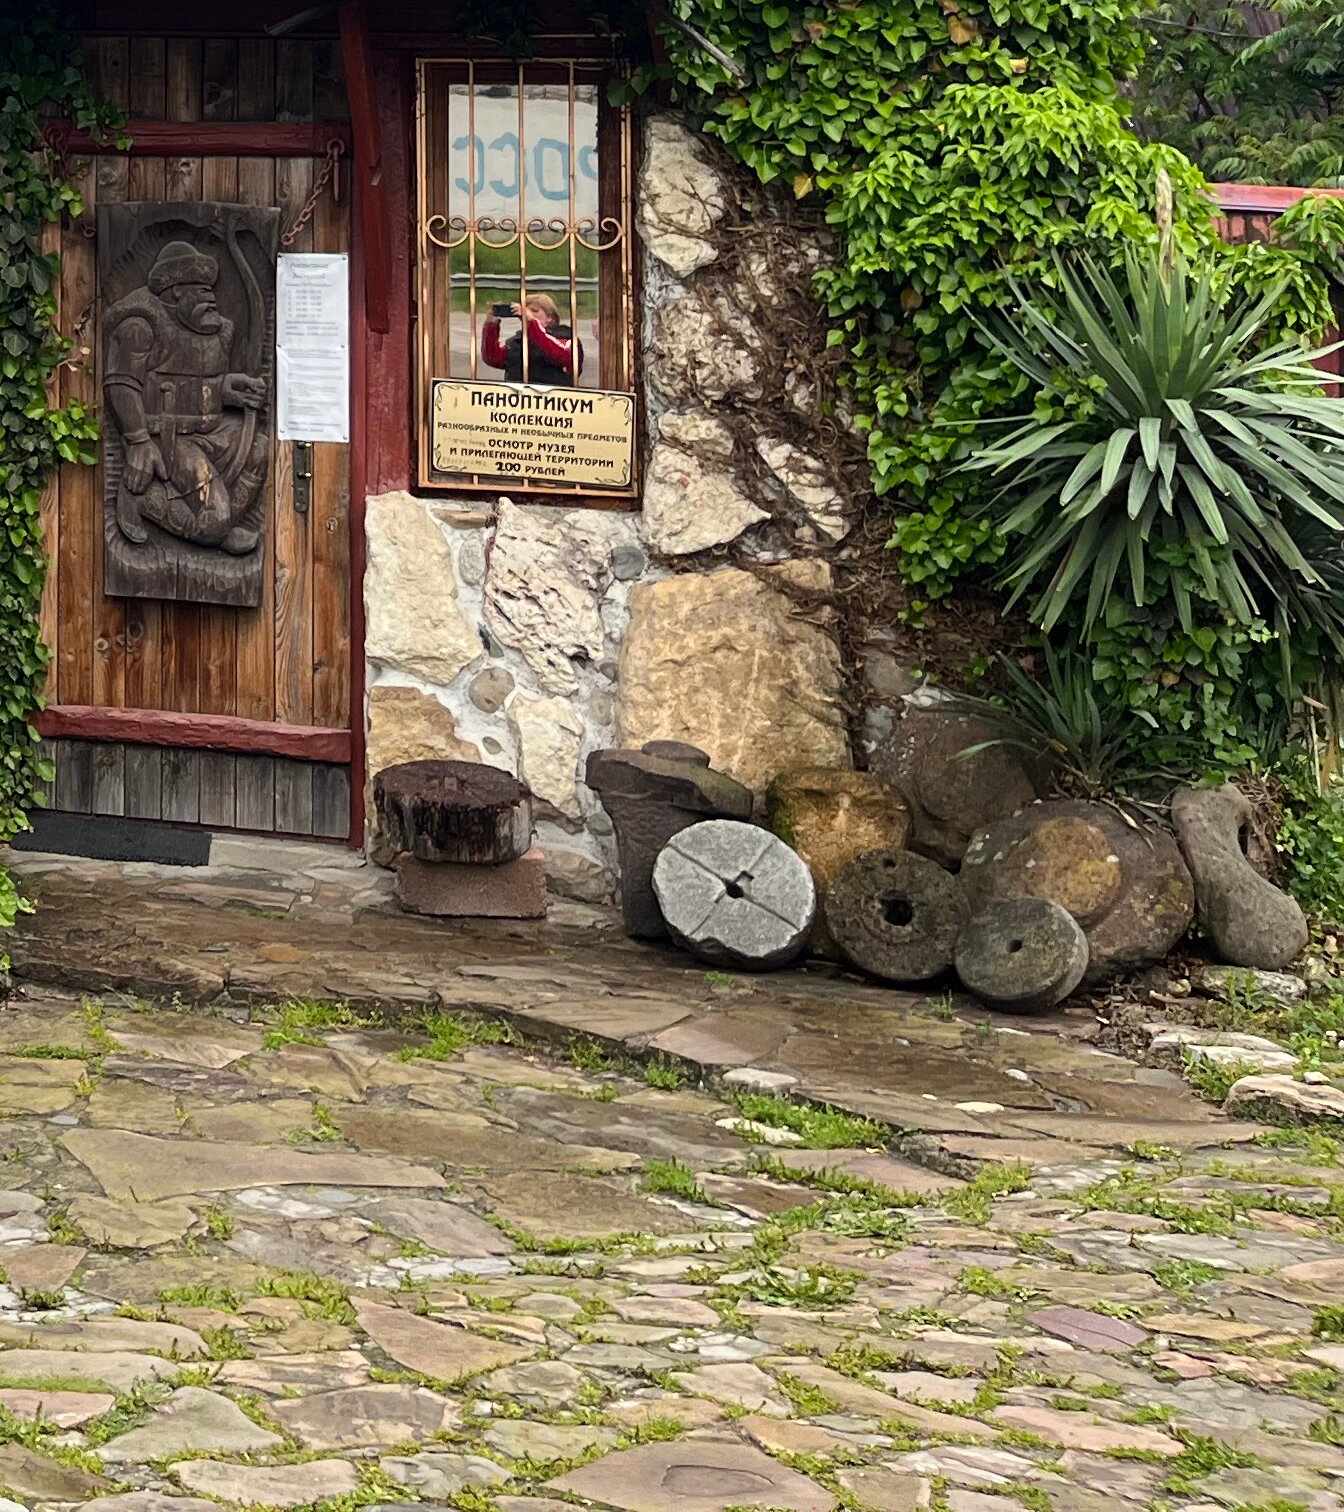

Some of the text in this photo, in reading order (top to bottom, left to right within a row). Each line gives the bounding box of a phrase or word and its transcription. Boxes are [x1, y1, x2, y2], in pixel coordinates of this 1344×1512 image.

[471, 391, 593, 413] ПАНОПТИКУМ
[490, 412, 573, 428] КОЛЛЕКЦИЯ
[437, 422, 509, 435] РАЗНООБРАЗНЫХ
[521, 429, 574, 439] НЕОБЫЧНЫХ
[577, 432, 627, 443] ПРЕДМЕТОВ
[488, 439, 533, 450] ОСМОТР
[538, 443, 575, 454] МУЗЕЯ
[450, 447, 614, 468] И ПРИЛЕГАЮЩЕЙ ТЕРРИТОРИИ
[495, 462, 565, 476] 200 РУБЛЕЙ
